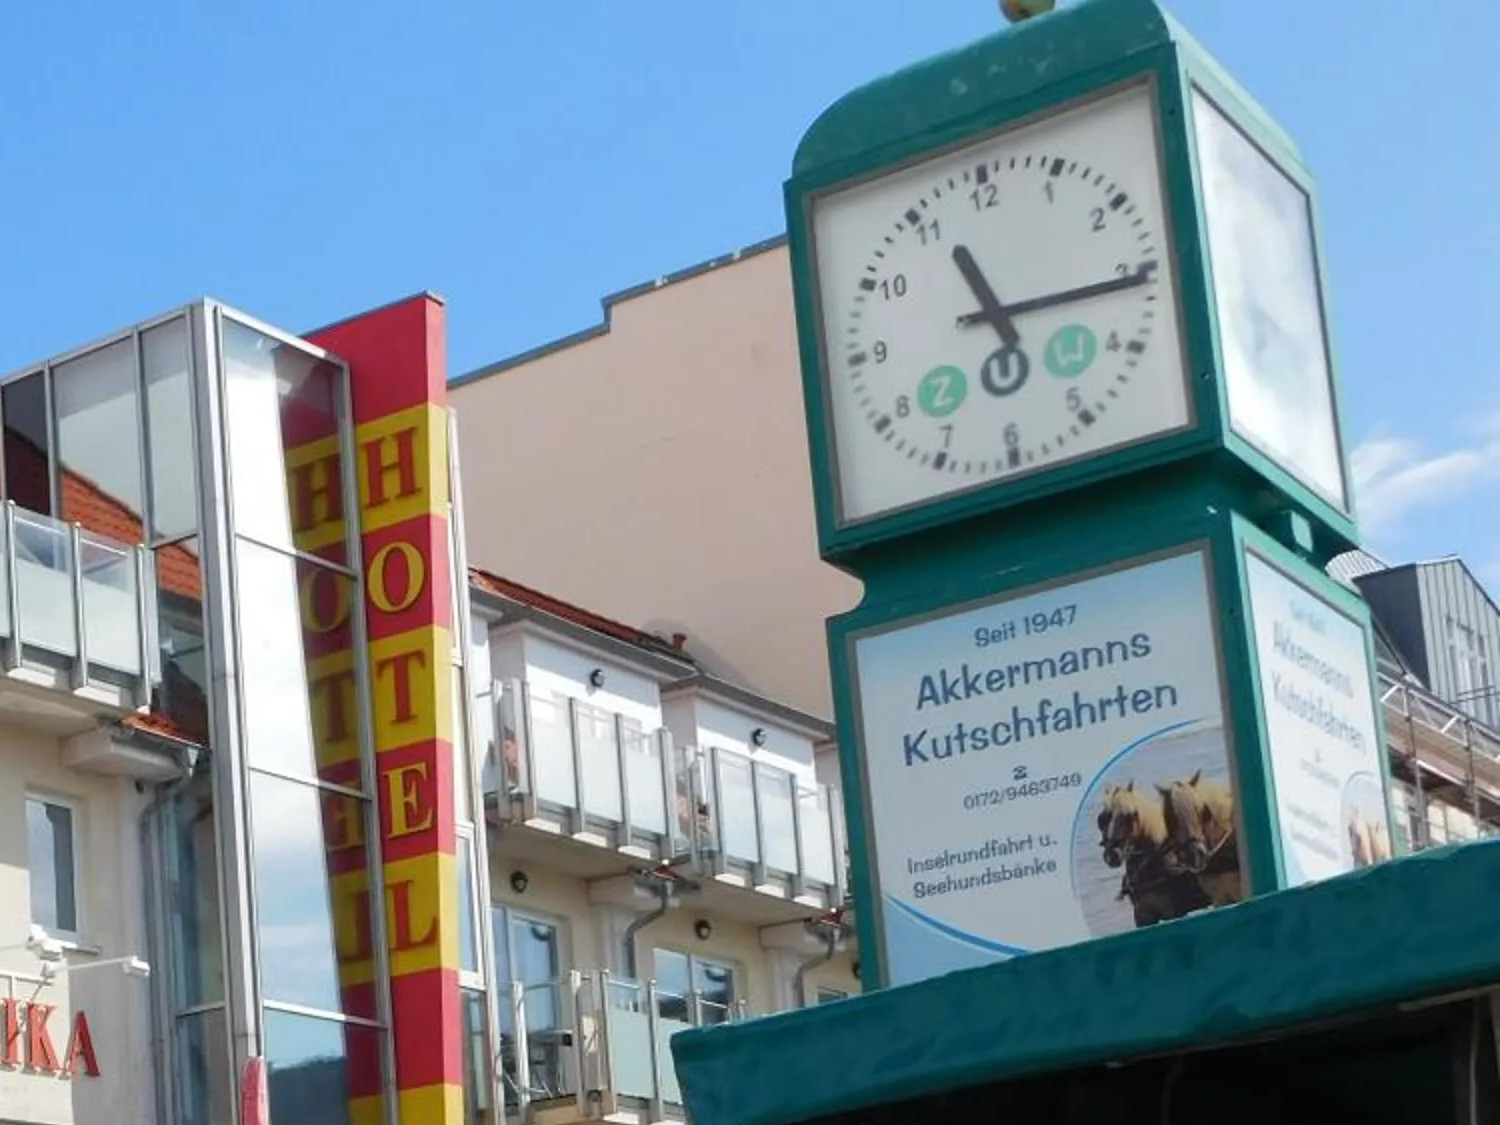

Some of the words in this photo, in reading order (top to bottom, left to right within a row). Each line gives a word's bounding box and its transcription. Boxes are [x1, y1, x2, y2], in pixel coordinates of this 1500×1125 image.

[969, 184, 999, 211] 12
[1044, 181, 1054, 204] 1
[916, 219, 940, 245] 11
[1090, 207, 1106, 232] 2
[879, 274, 907, 300] 10
[873, 340, 887, 363] 9
[1105, 330, 1122, 353] 4
[896, 395, 910, 418] 8
[1066, 387, 1081, 412] 5
[940, 424, 953, 447] 7
[1004, 423, 1019, 446] 6
[974, 624, 1016, 647] Seit
[1024, 604, 1077, 635] 1947
[916, 633, 1151, 710] Akkermanns
[362, 425, 439, 957] HOTEL
[902, 684, 1177, 767] Kutschfahrten
[907, 834, 1032, 875] Inselrundfahrt
[1039, 833, 1058, 847] u.
